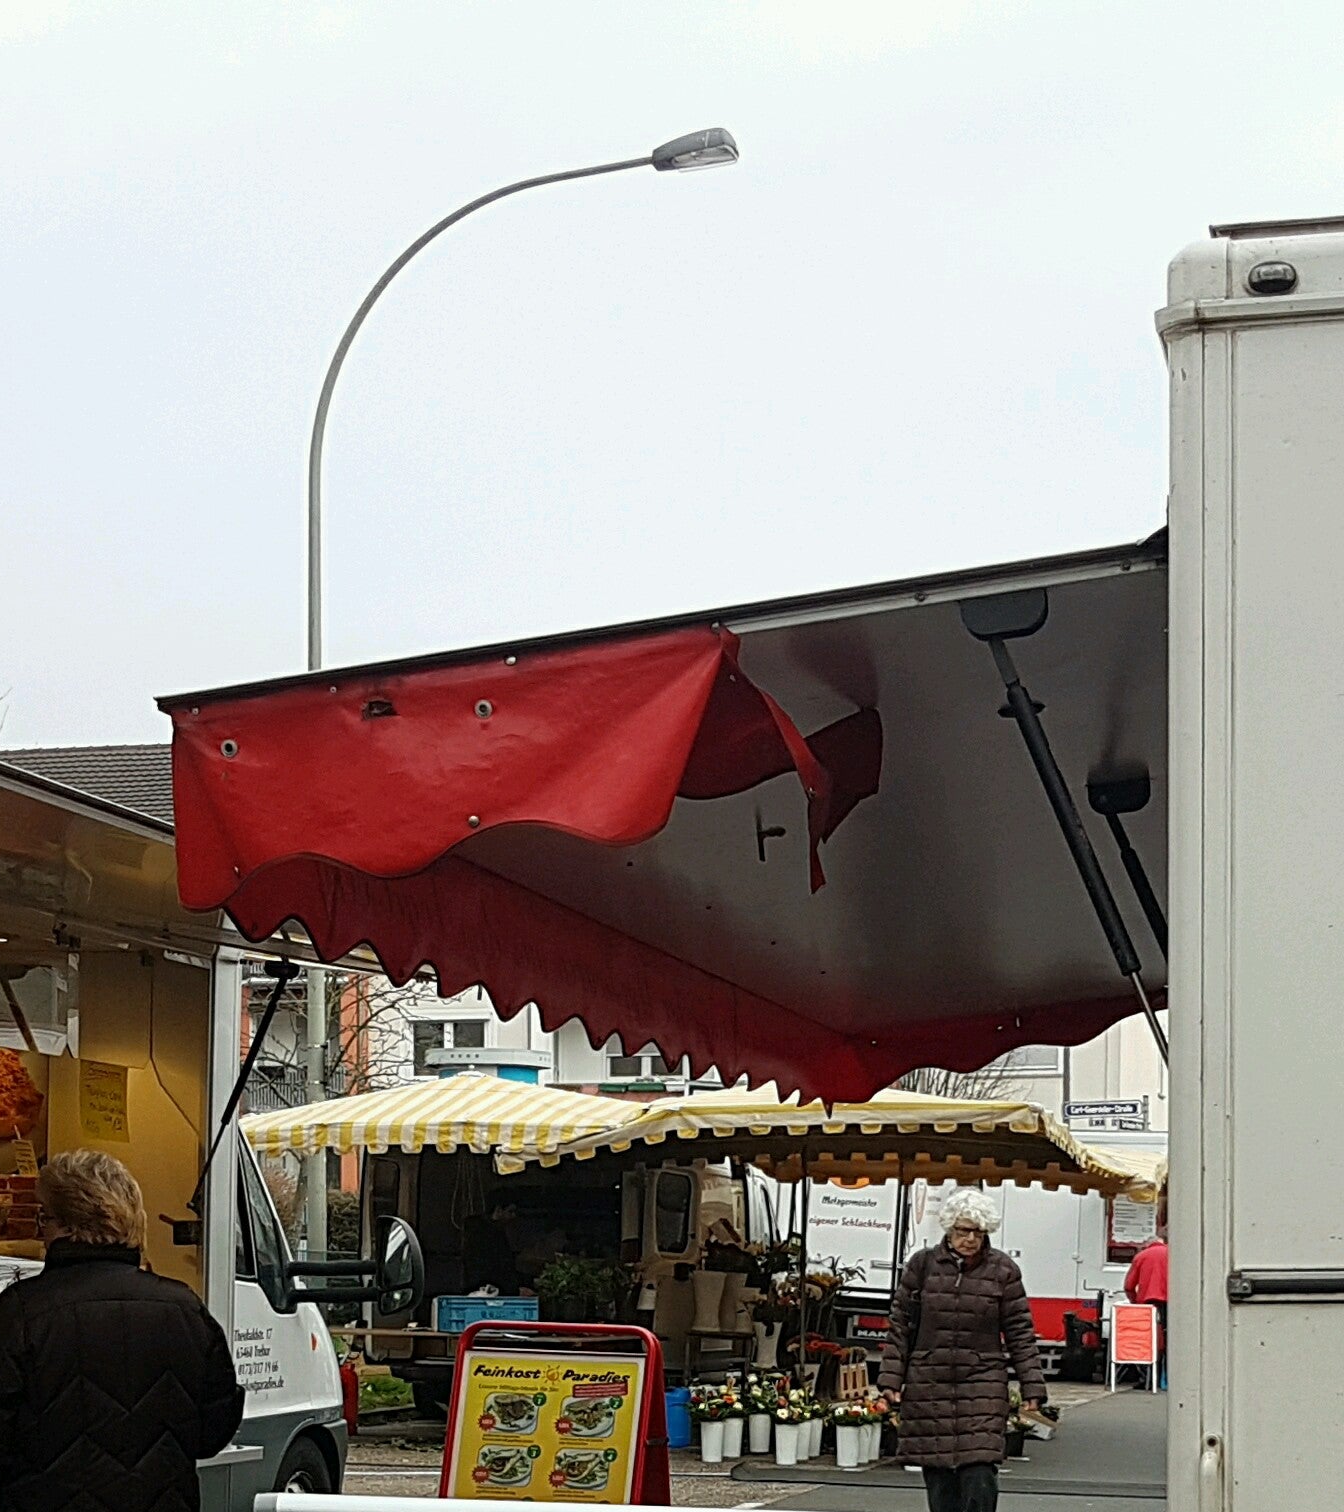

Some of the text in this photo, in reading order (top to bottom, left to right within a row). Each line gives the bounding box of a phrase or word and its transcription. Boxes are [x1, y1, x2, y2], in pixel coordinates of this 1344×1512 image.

[857, 1329, 889, 1339] MAN
[472, 1364, 631, 1384] Feinkost Paradies
